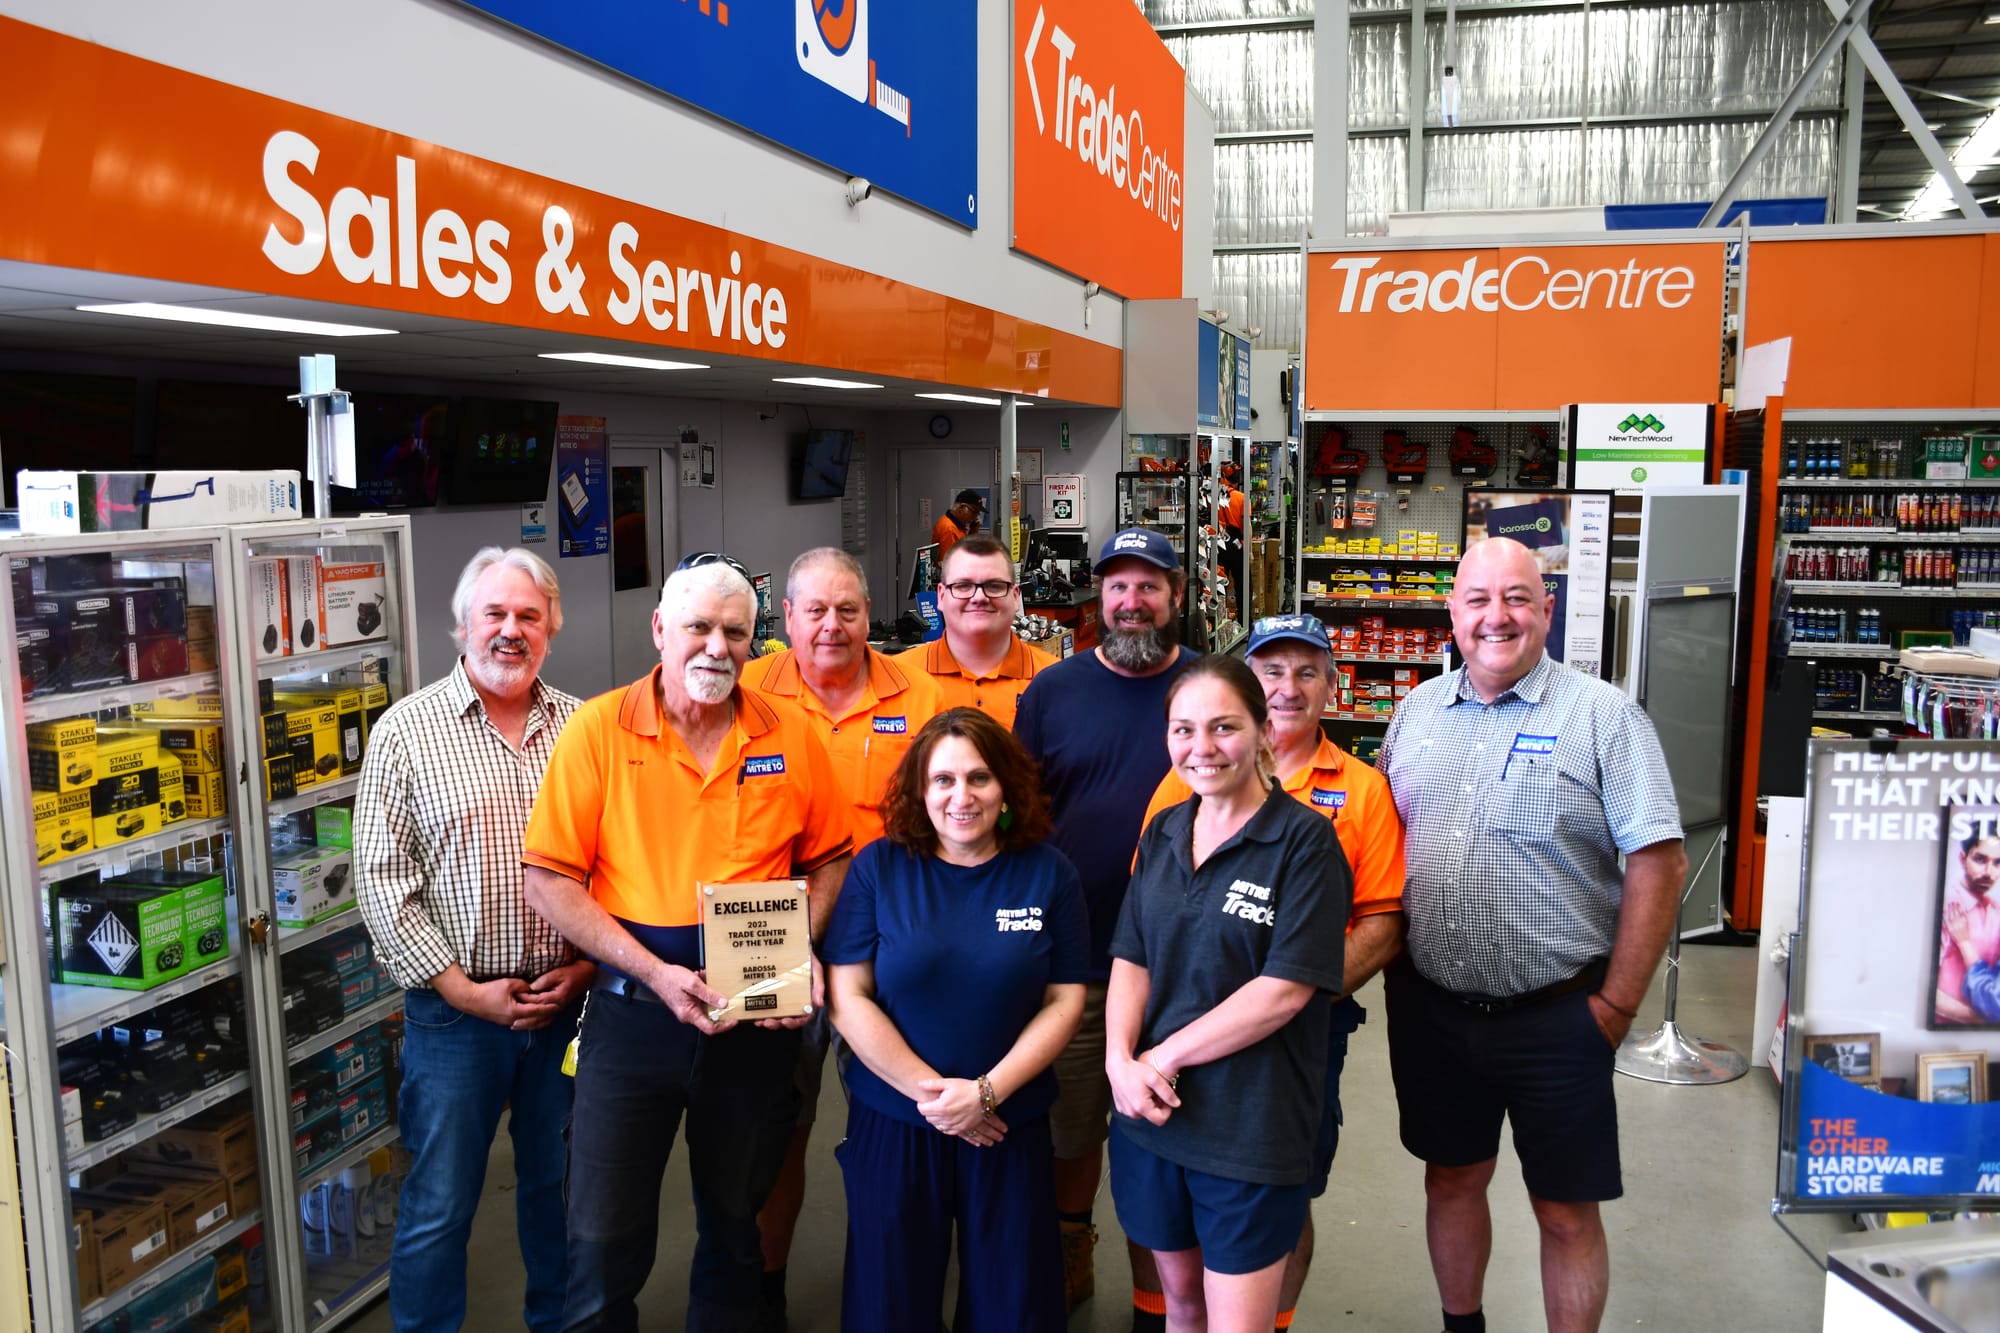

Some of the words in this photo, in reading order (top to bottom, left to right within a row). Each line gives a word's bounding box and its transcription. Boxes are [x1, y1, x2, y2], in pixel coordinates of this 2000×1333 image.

[1051, 25, 1180, 231] TradeCentre
[262, 130, 512, 304] Sales
[535, 205, 590, 316] &
[607, 222, 787, 348] Service
[1330, 256, 1694, 313] TradeCentre
[1499, 523, 1536, 534] barossa
[60, 727, 95, 739] STANLEY
[896, 723, 905, 731] 10
[110, 752, 142, 765] STANLEY
[1832, 752, 2000, 772] HELPFUL
[747, 764, 772, 773] MITRE
[773, 763, 783, 771] 10
[1831, 778, 1928, 807] THAT
[1939, 778, 2000, 807] KN
[1829, 812, 1939, 841] THEIR
[1950, 812, 2000, 841] ST
[714, 899, 798, 915] EXCELLENCE
[1029, 906, 1042, 916] 10
[996, 916, 1043, 931] Trade
[728, 931, 754, 939] TRADE
[757, 929, 787, 937] CENTRE
[743, 965, 776, 973] BAROSSA
[1809, 1118, 1857, 1136] THE
[1809, 1138, 1888, 1156] OTHER
[1807, 1156, 1944, 1176] HARDWARE
[1807, 1176, 1884, 1195] STORE
